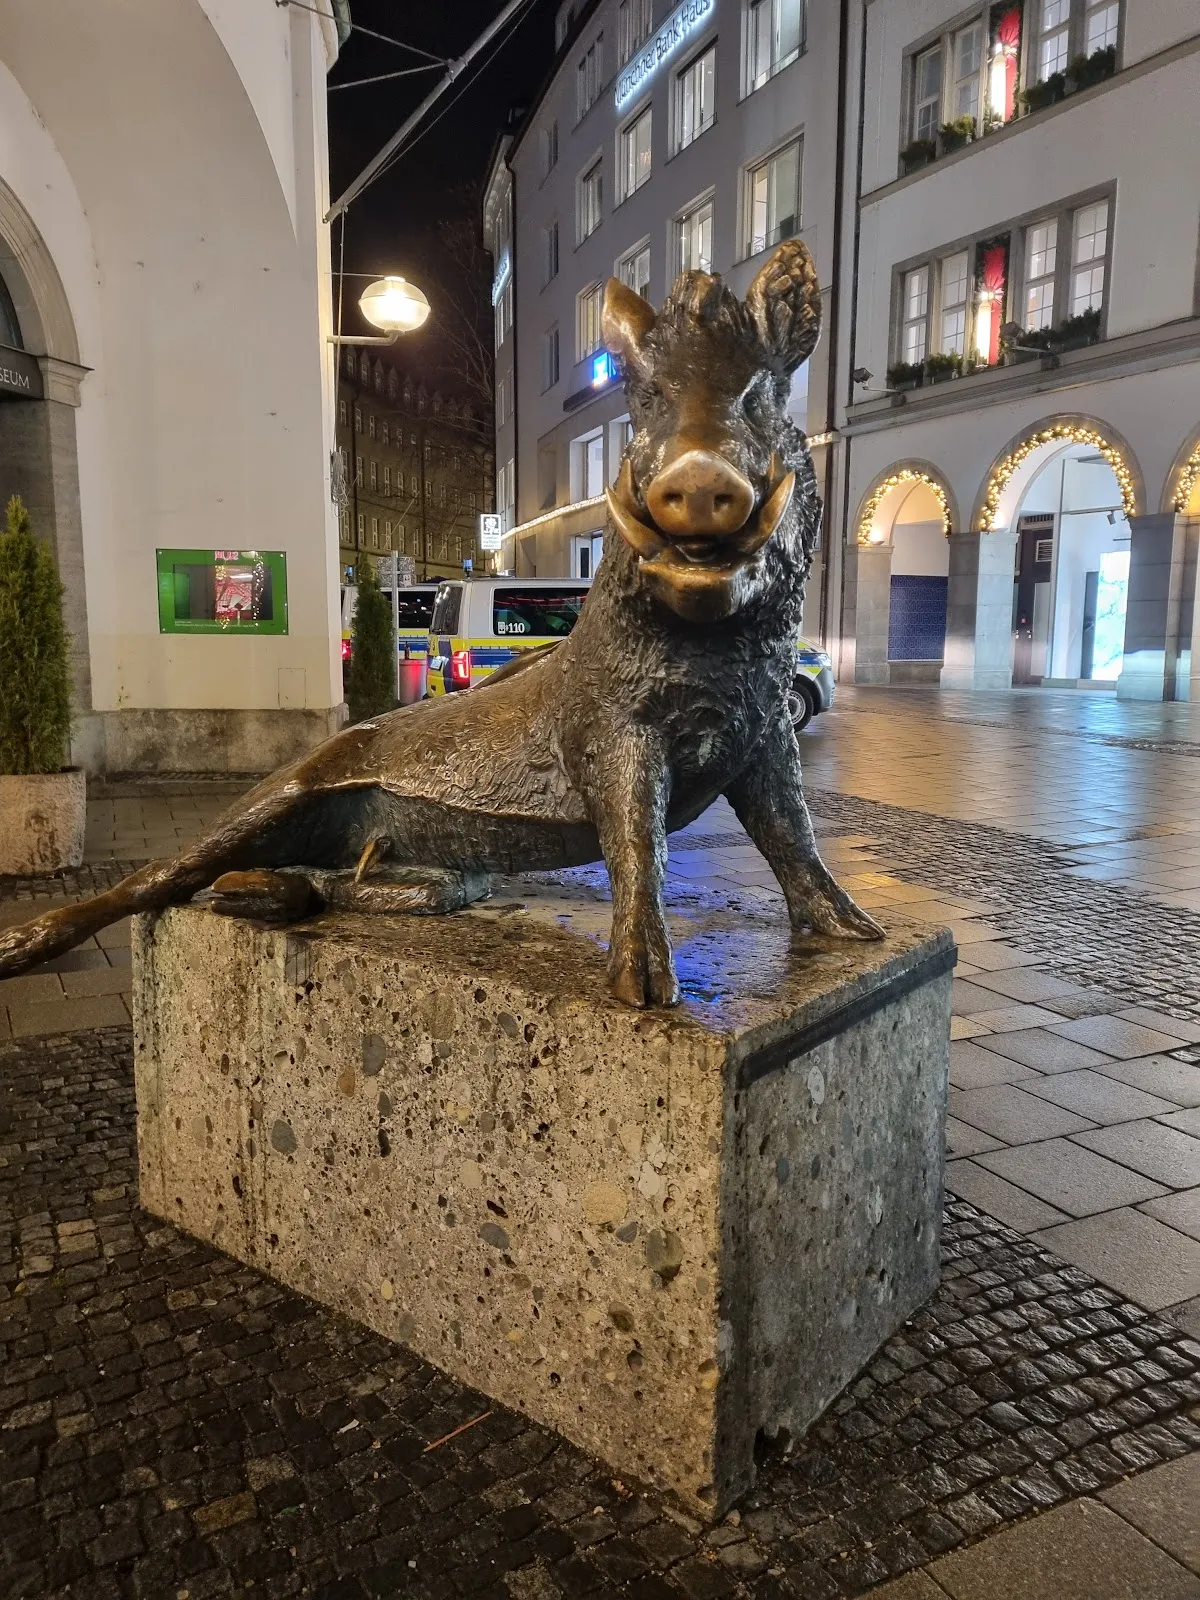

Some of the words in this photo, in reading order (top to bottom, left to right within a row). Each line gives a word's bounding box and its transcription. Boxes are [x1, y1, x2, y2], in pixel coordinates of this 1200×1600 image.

[655, 19, 682, 60] Bank
[681, 0, 711, 31] Haus
[508, 622, 525, 633] 110
